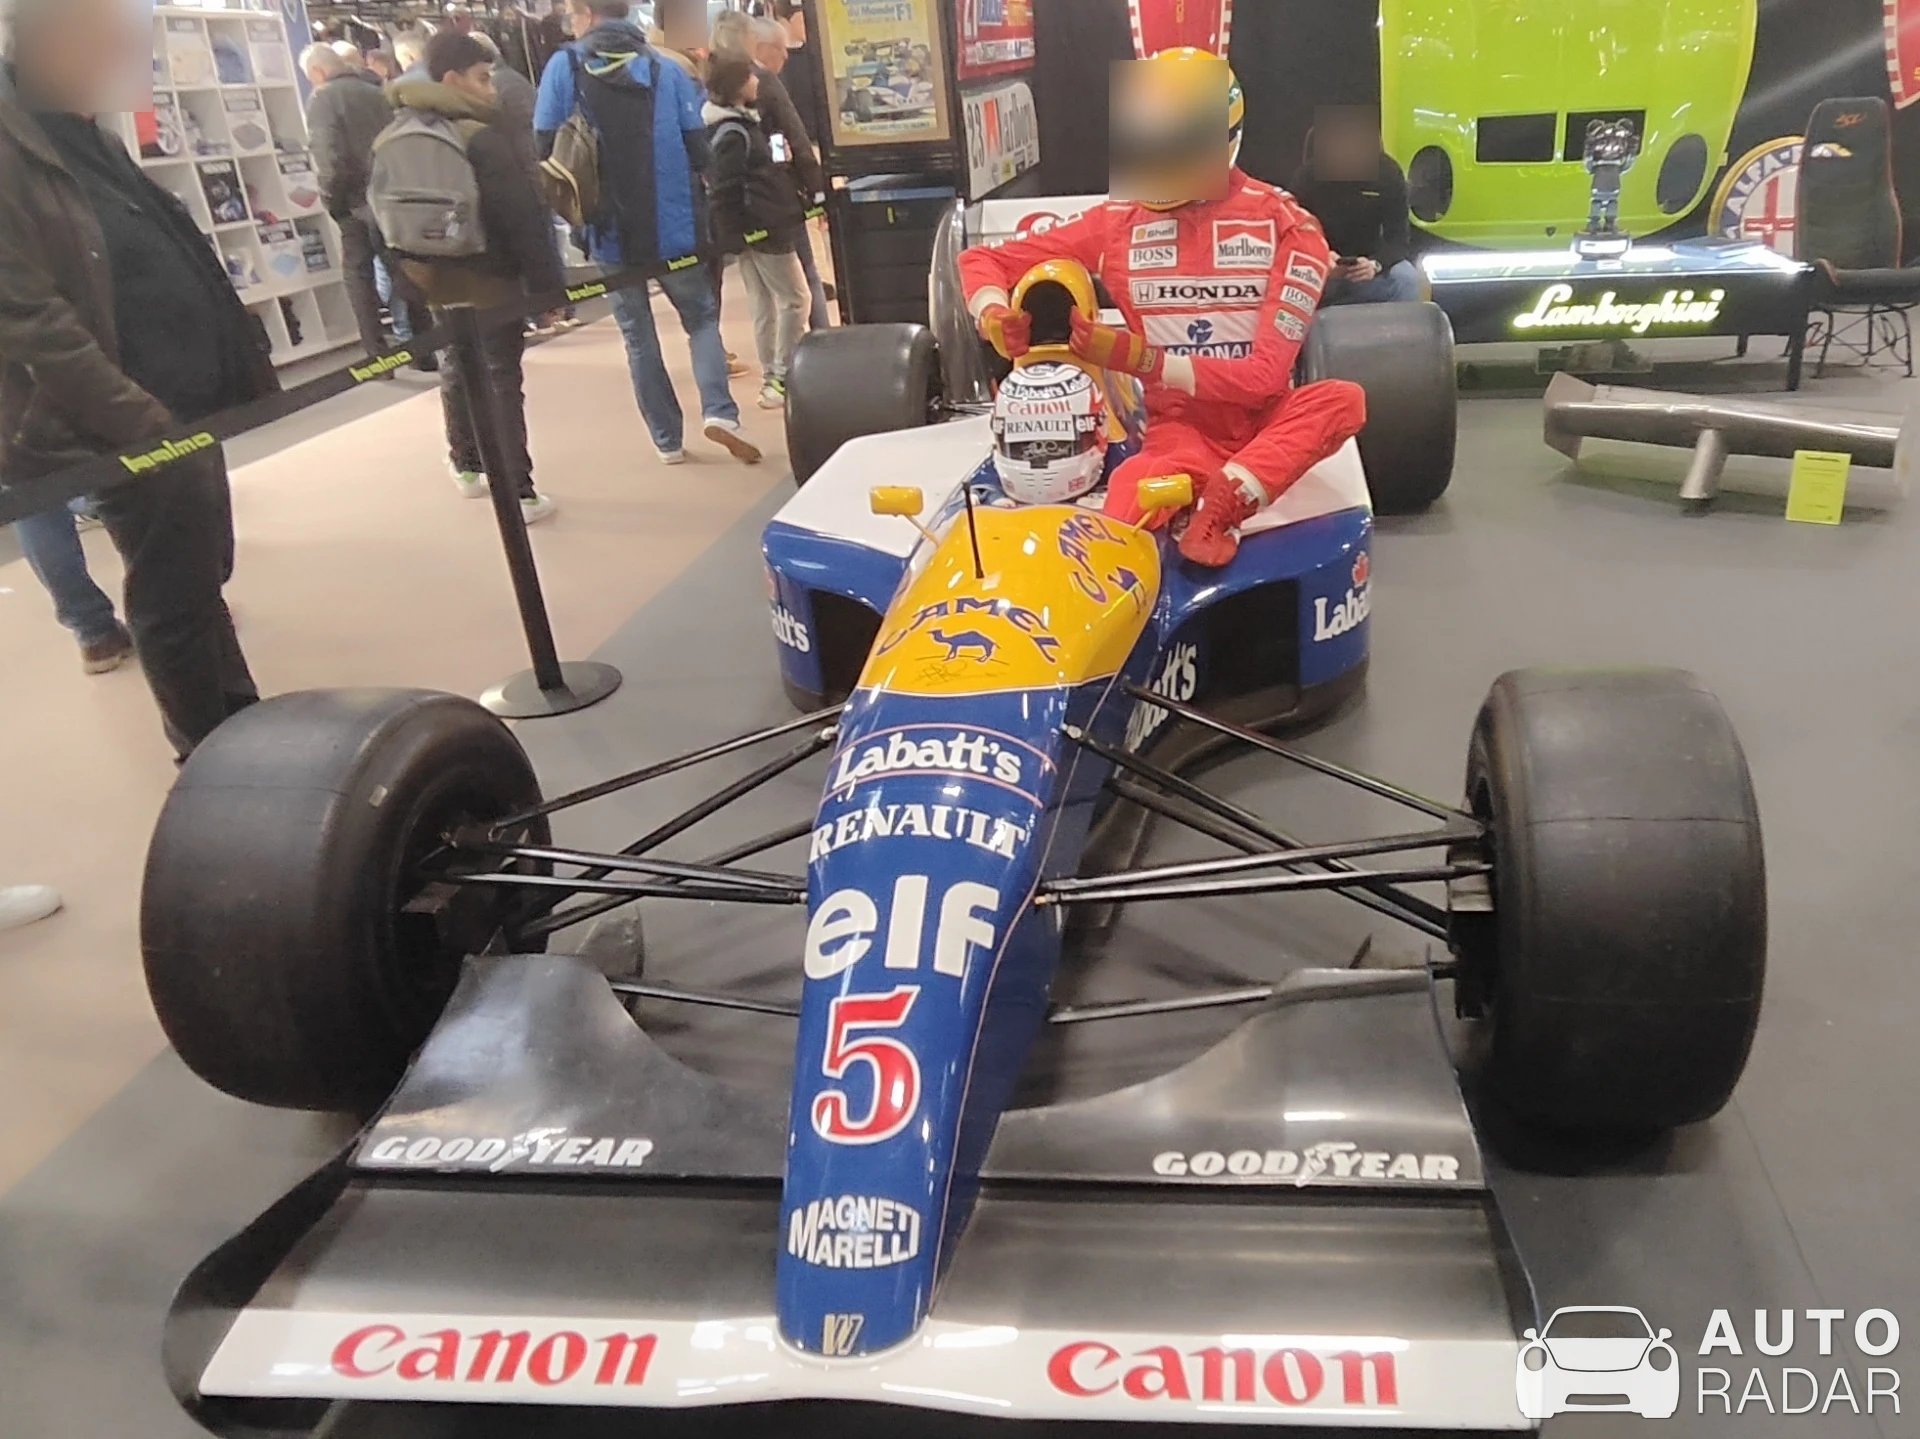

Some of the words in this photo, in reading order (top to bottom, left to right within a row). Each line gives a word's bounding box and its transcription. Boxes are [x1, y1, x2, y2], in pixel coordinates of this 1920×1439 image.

[1132, 247, 1174, 263] BOSS
[1218, 237, 1272, 258] Marlboro
[1158, 285, 1261, 299] HONDA
[1513, 284, 1725, 333] Lamborghini
[1006, 419, 1071, 434] RENAULT
[1007, 401, 1071, 416] Canon
[1076, 416, 1096, 433] elf
[1058, 513, 1128, 604] CAMEL
[875, 597, 1062, 665] CAMEL
[832, 732, 1022, 790] Labatt's
[808, 803, 1026, 864] RENAULT
[803, 874, 1000, 980] elf
[811, 984, 922, 1146] 5
[788, 1194, 920, 1247] MAGNETI
[788, 1219, 920, 1268] MARELLI
[331, 1324, 658, 1386] Canon
[1047, 1341, 1398, 1406] Canon
